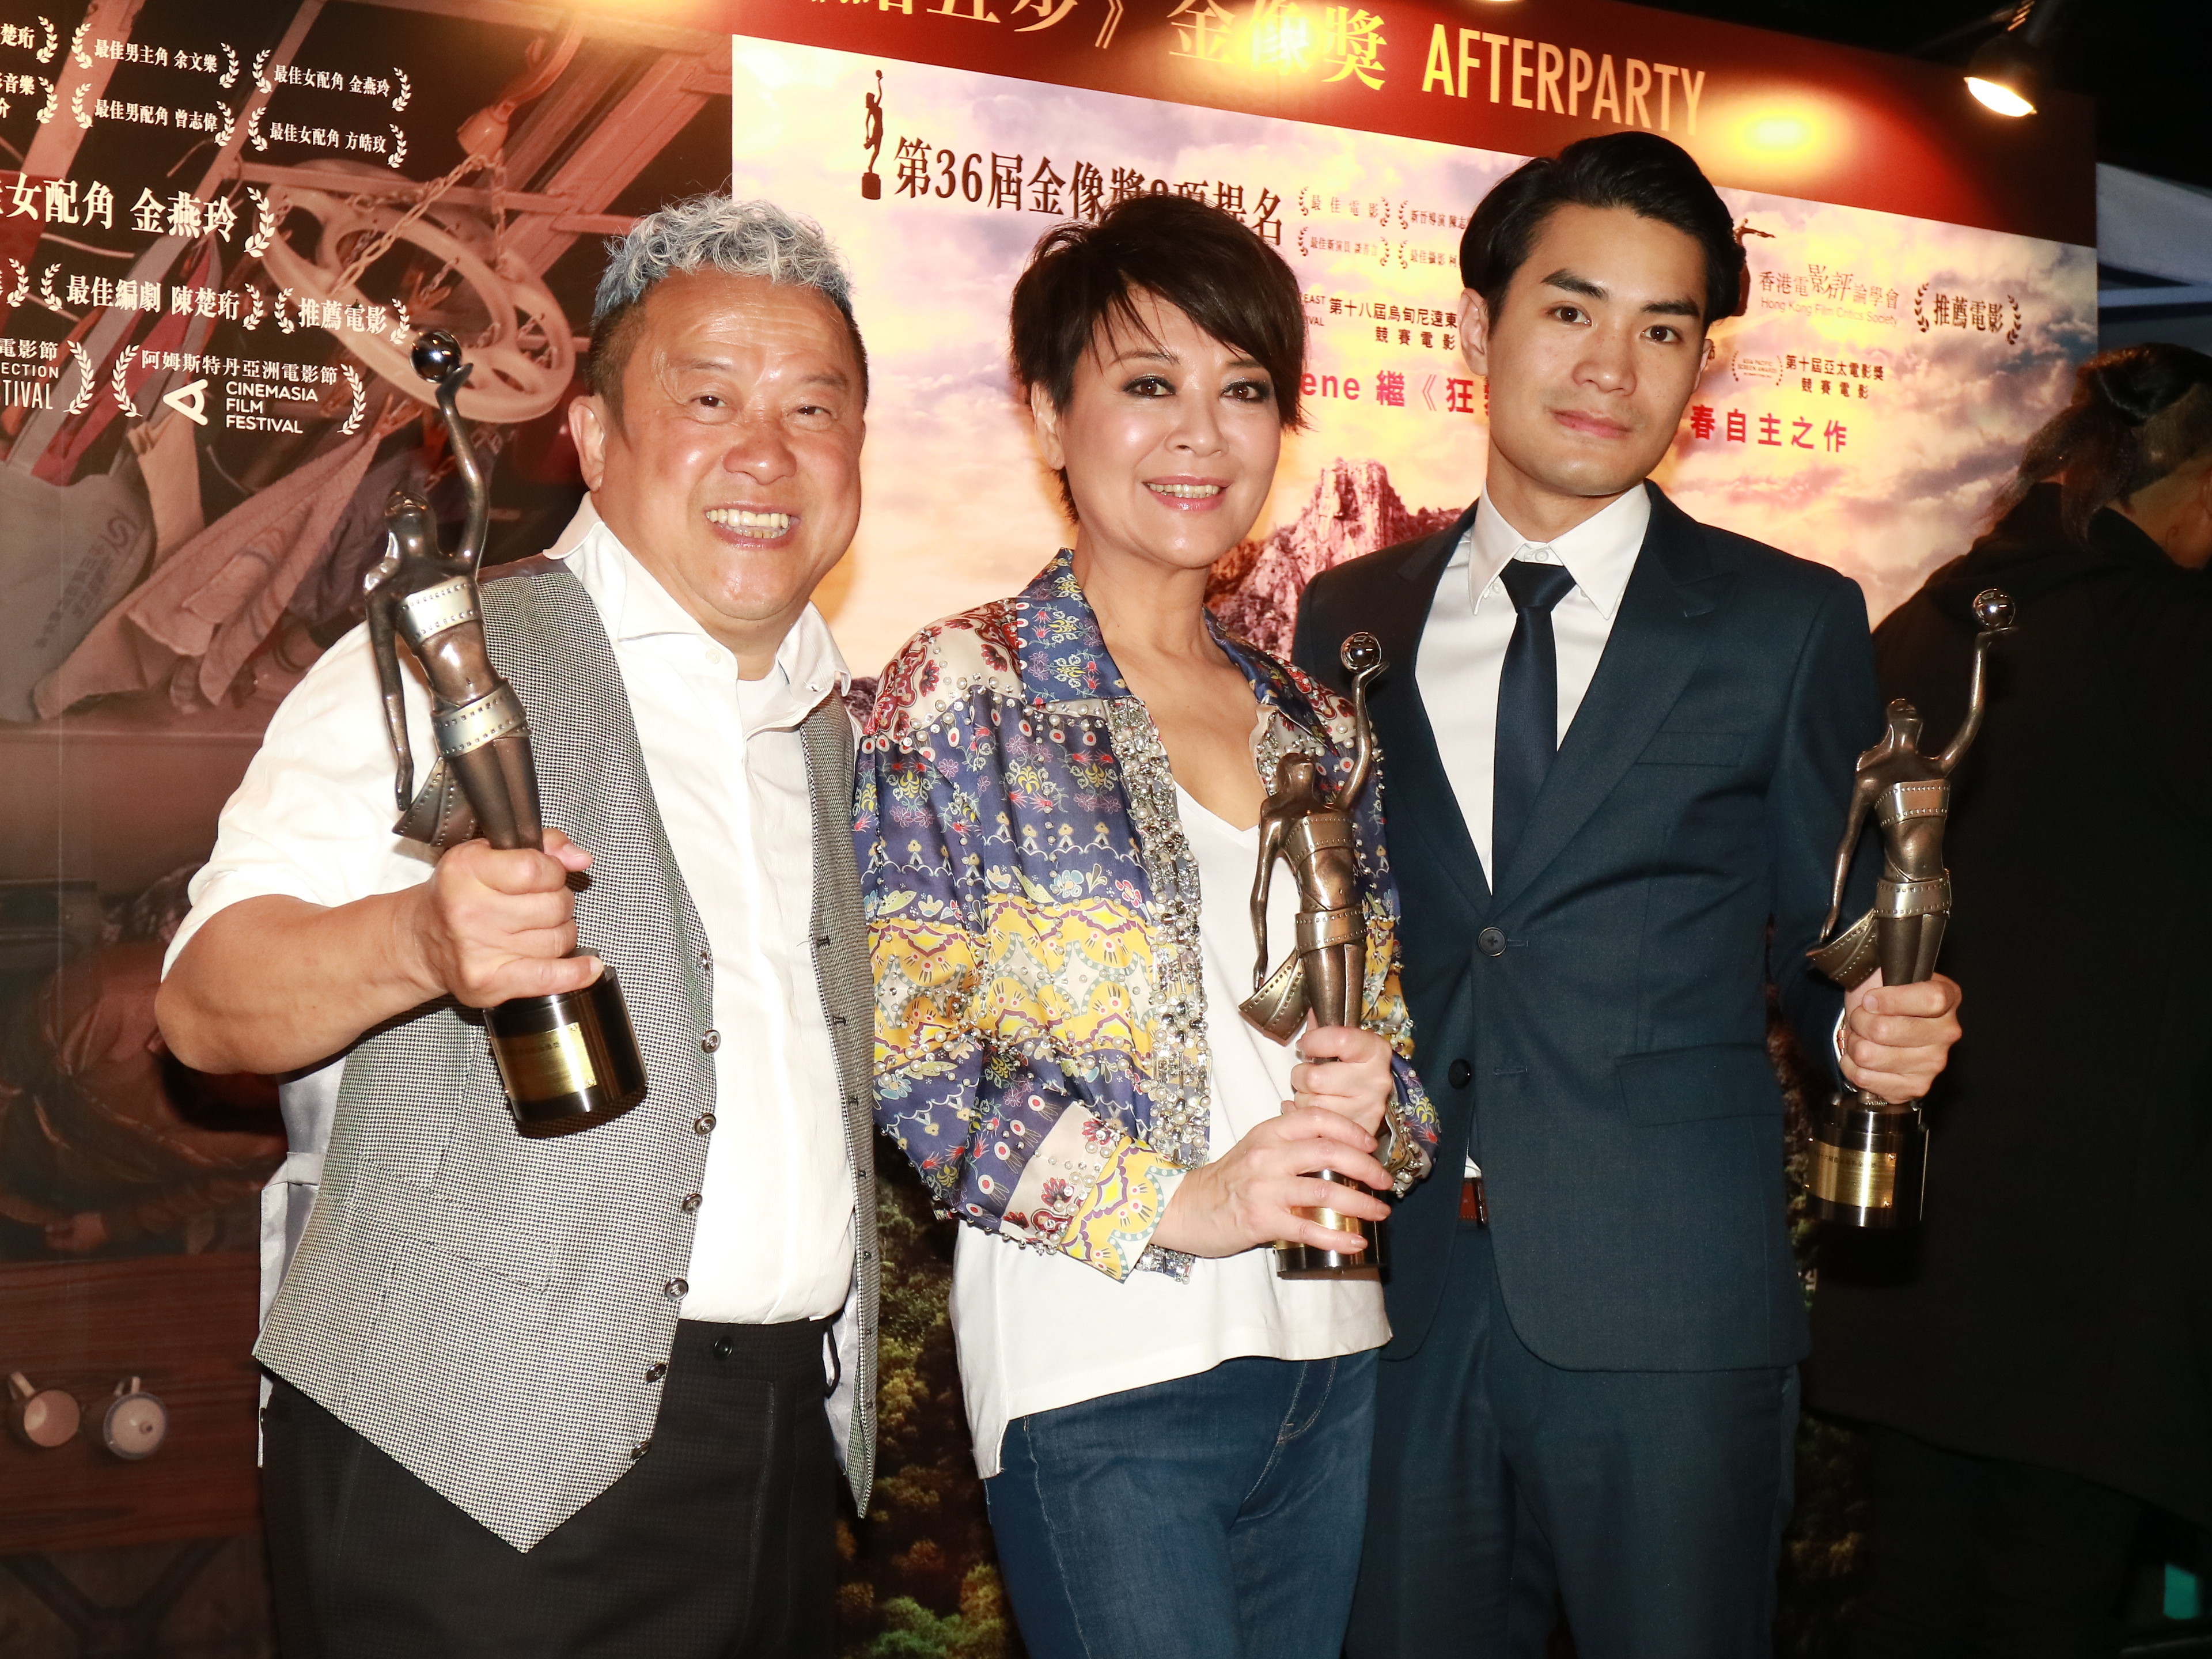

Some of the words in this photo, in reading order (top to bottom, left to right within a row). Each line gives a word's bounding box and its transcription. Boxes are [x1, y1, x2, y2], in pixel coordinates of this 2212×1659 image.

[94, 39, 168, 67] 最佳男主角
[173, 50, 218, 74] 余文樂
[0, 72, 35, 96] 音樂
[274, 65, 343, 91] 最佳女配角
[349, 74, 391, 98] 金燕玲
[1422, 24, 1705, 136] AFTERPARTY
[94, 99, 168, 126] 最佳男配角
[175, 109, 218, 132] 曾志偉
[270, 122, 340, 149] 最佳女配角
[345, 131, 387, 154] 方皓玟
[0, 172, 114, 230] 女配角
[130, 186, 238, 243] 金燕玲
[66, 274, 161, 313] 最佳編劇
[172, 285, 240, 321] 陳楚珩
[1304, 293, 1325, 305] EAST
[1759, 264, 1899, 310] 香港電影評論學會
[298, 297, 388, 335] 推薦電影
[1761, 297, 1786, 313] Hong
[1789, 301, 1812, 316] Kong
[1866, 311, 1900, 327] Society
[1933, 291, 2003, 335] 推薦電影
[1375, 326, 1456, 351] 競賽電影
[1, 362, 59, 379] ECTION
[141, 349, 338, 385] 阿姆斯特丹亞洲電影節
[3, 379, 53, 410] TIVAL
[226, 381, 318, 402] CINEMASIA
[226, 398, 263, 414] FILM
[226, 415, 303, 434] FESTIVAL
[1690, 404, 1847, 453] 春自主之作
